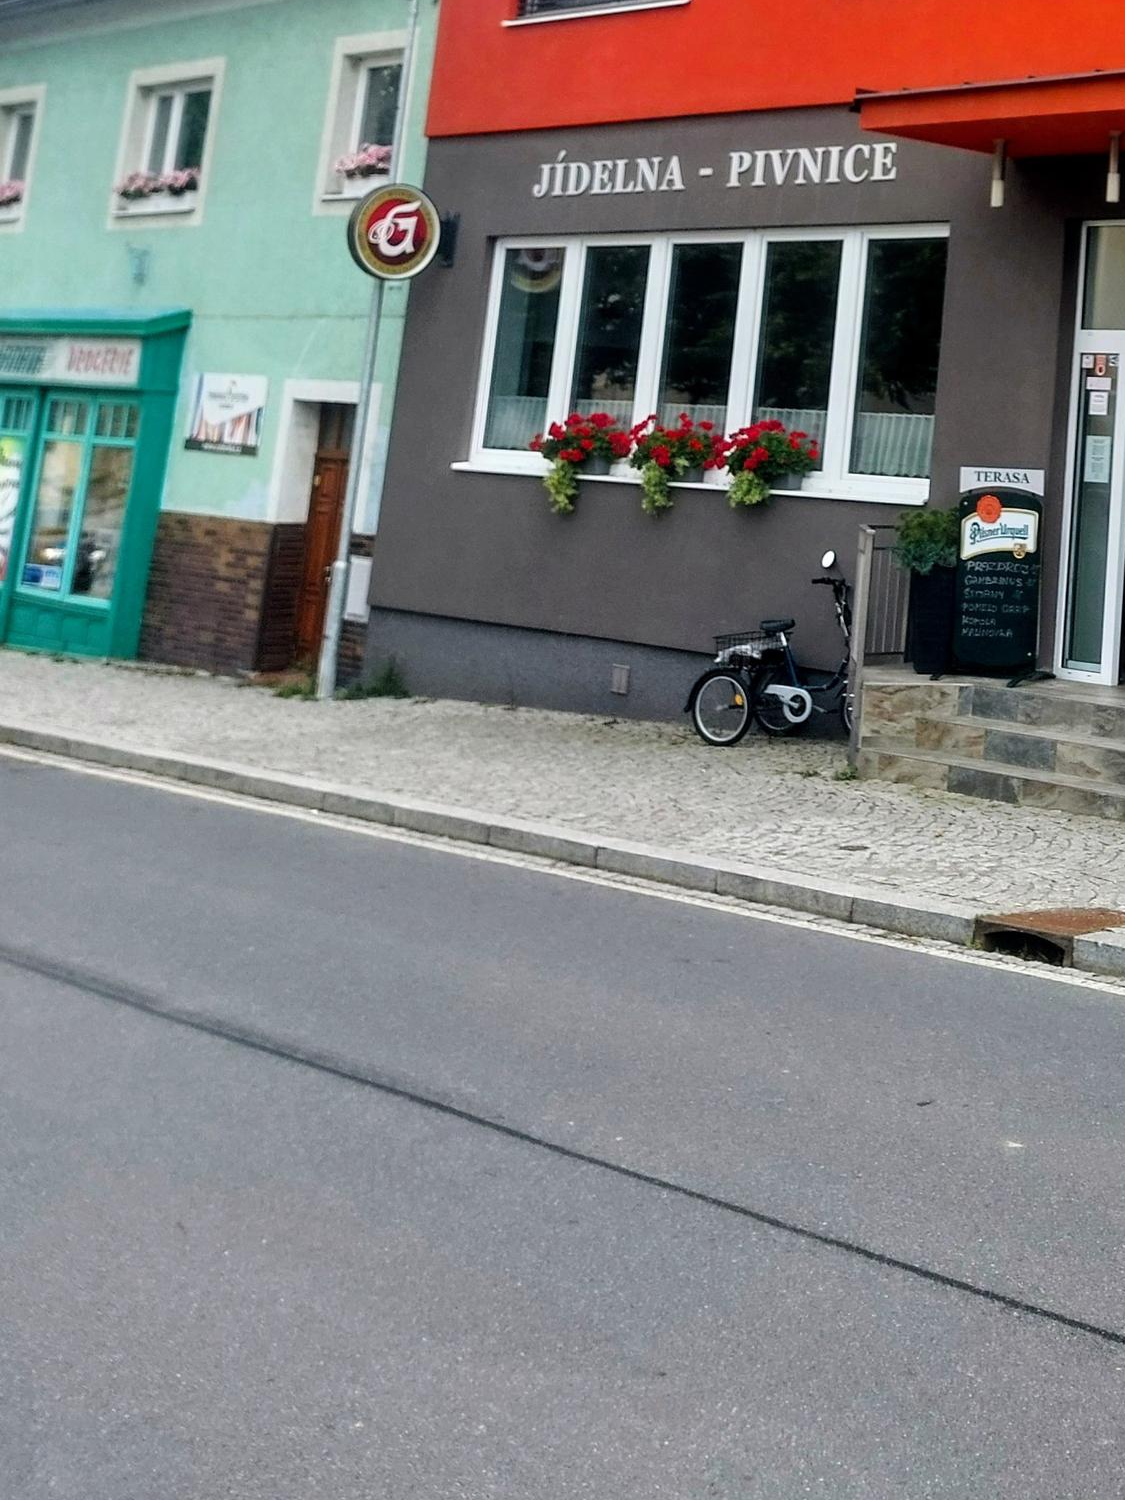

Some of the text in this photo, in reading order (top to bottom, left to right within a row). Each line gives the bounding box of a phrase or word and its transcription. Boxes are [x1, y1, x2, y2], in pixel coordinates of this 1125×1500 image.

[532, 149, 685, 198] JÍDELNA
[725, 142, 898, 187] PIVNICE
[974, 470, 1030, 484] TERASA
[969, 522, 1029, 545] Pilsner Urquell
